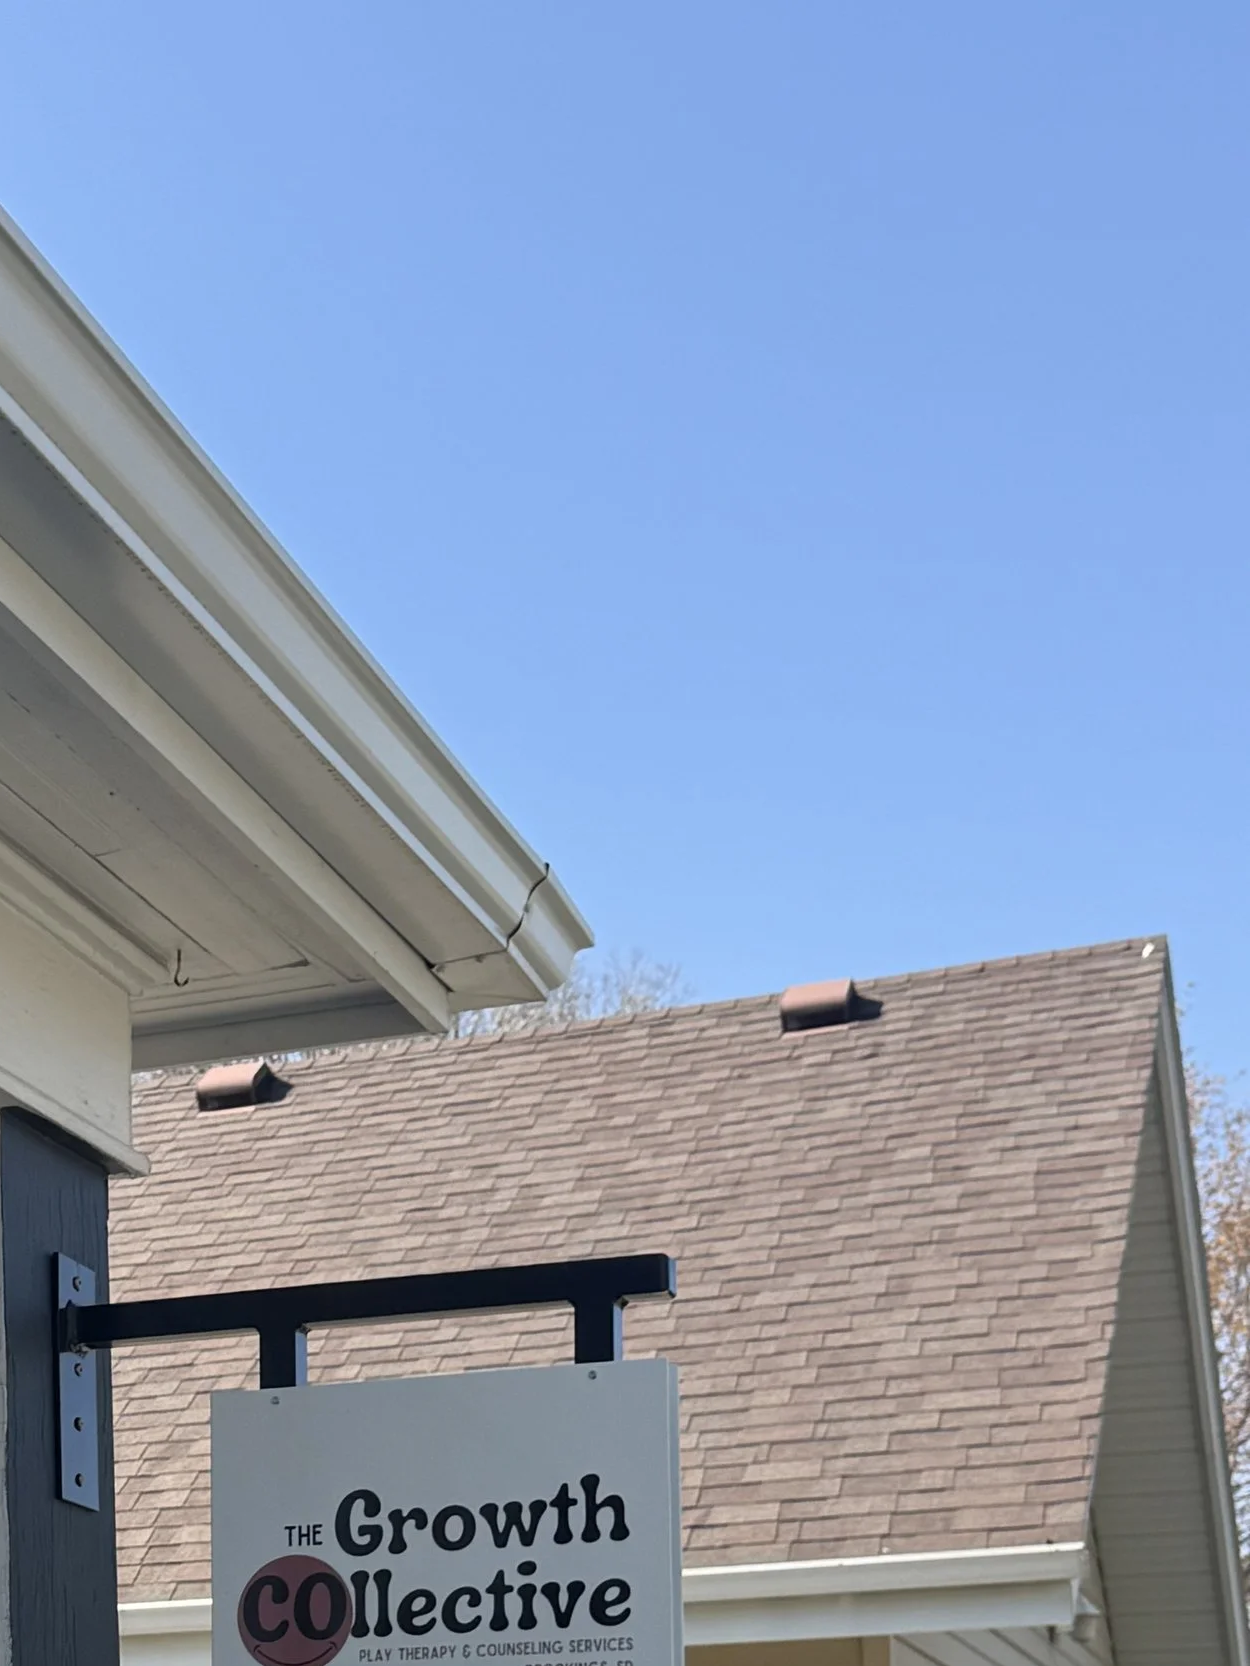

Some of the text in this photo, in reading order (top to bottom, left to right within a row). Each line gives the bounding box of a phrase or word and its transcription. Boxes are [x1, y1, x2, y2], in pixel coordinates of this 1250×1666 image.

[284, 1473, 630, 1557] THE Growth
[358, 1637, 634, 1663] PLAY THERAPY & COUNSELING SERVICES
